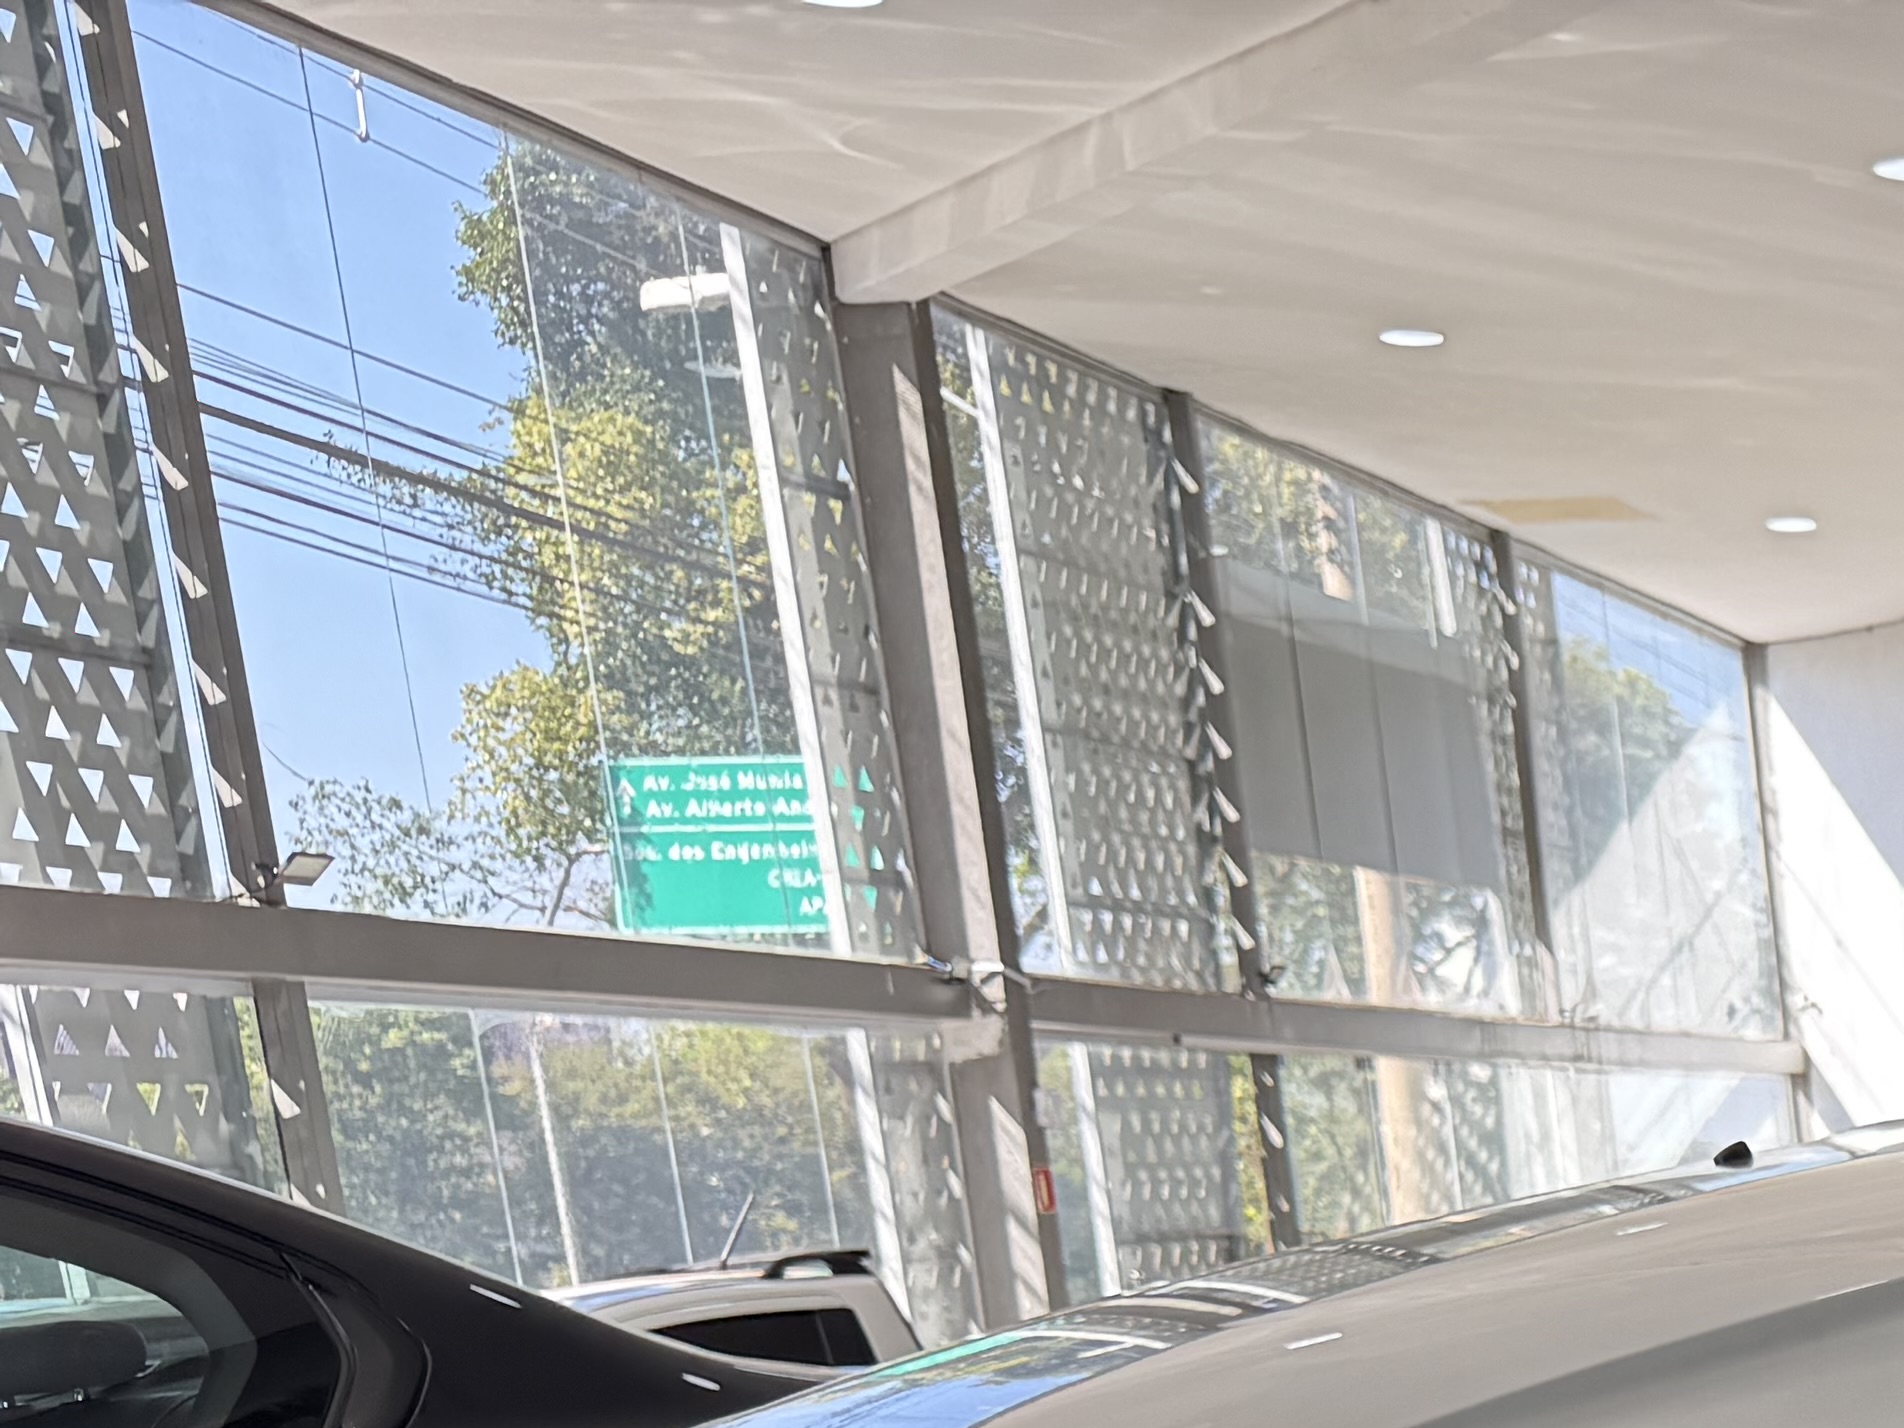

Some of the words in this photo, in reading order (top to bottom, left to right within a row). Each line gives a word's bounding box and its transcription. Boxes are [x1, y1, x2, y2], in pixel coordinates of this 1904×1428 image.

[642, 774, 676, 792] Av.
[680, 766, 732, 792] José
[645, 799, 680, 818] Av.
[685, 796, 767, 817] Alberto
